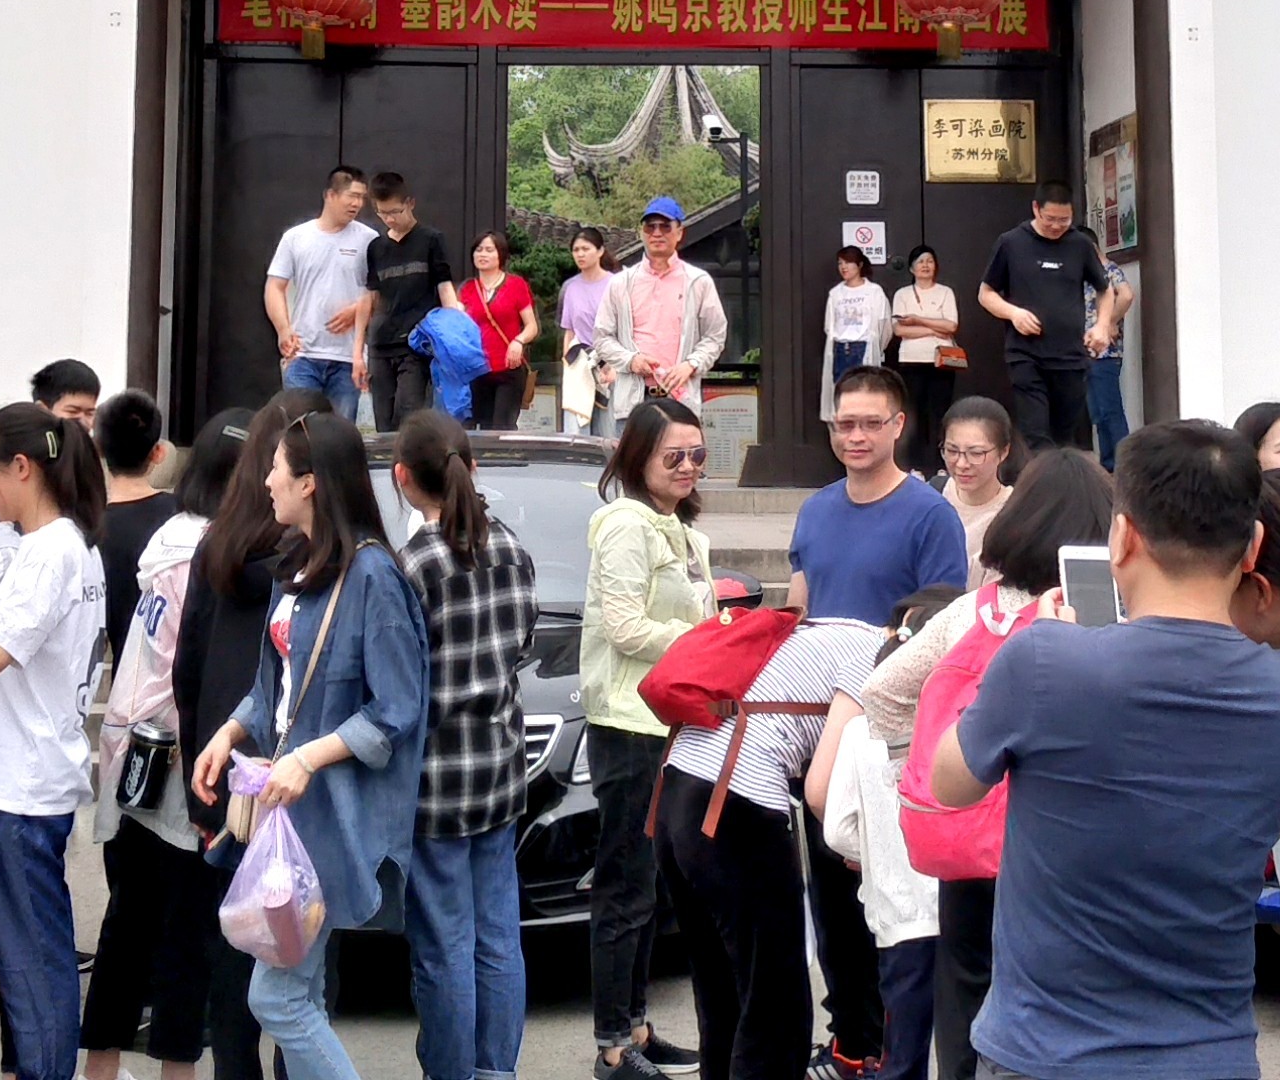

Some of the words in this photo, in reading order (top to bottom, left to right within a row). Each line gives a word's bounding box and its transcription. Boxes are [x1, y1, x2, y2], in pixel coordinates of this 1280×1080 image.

[931, 118, 1027, 139] 李可染画院
[951, 147, 1009, 161] 苏州分院
